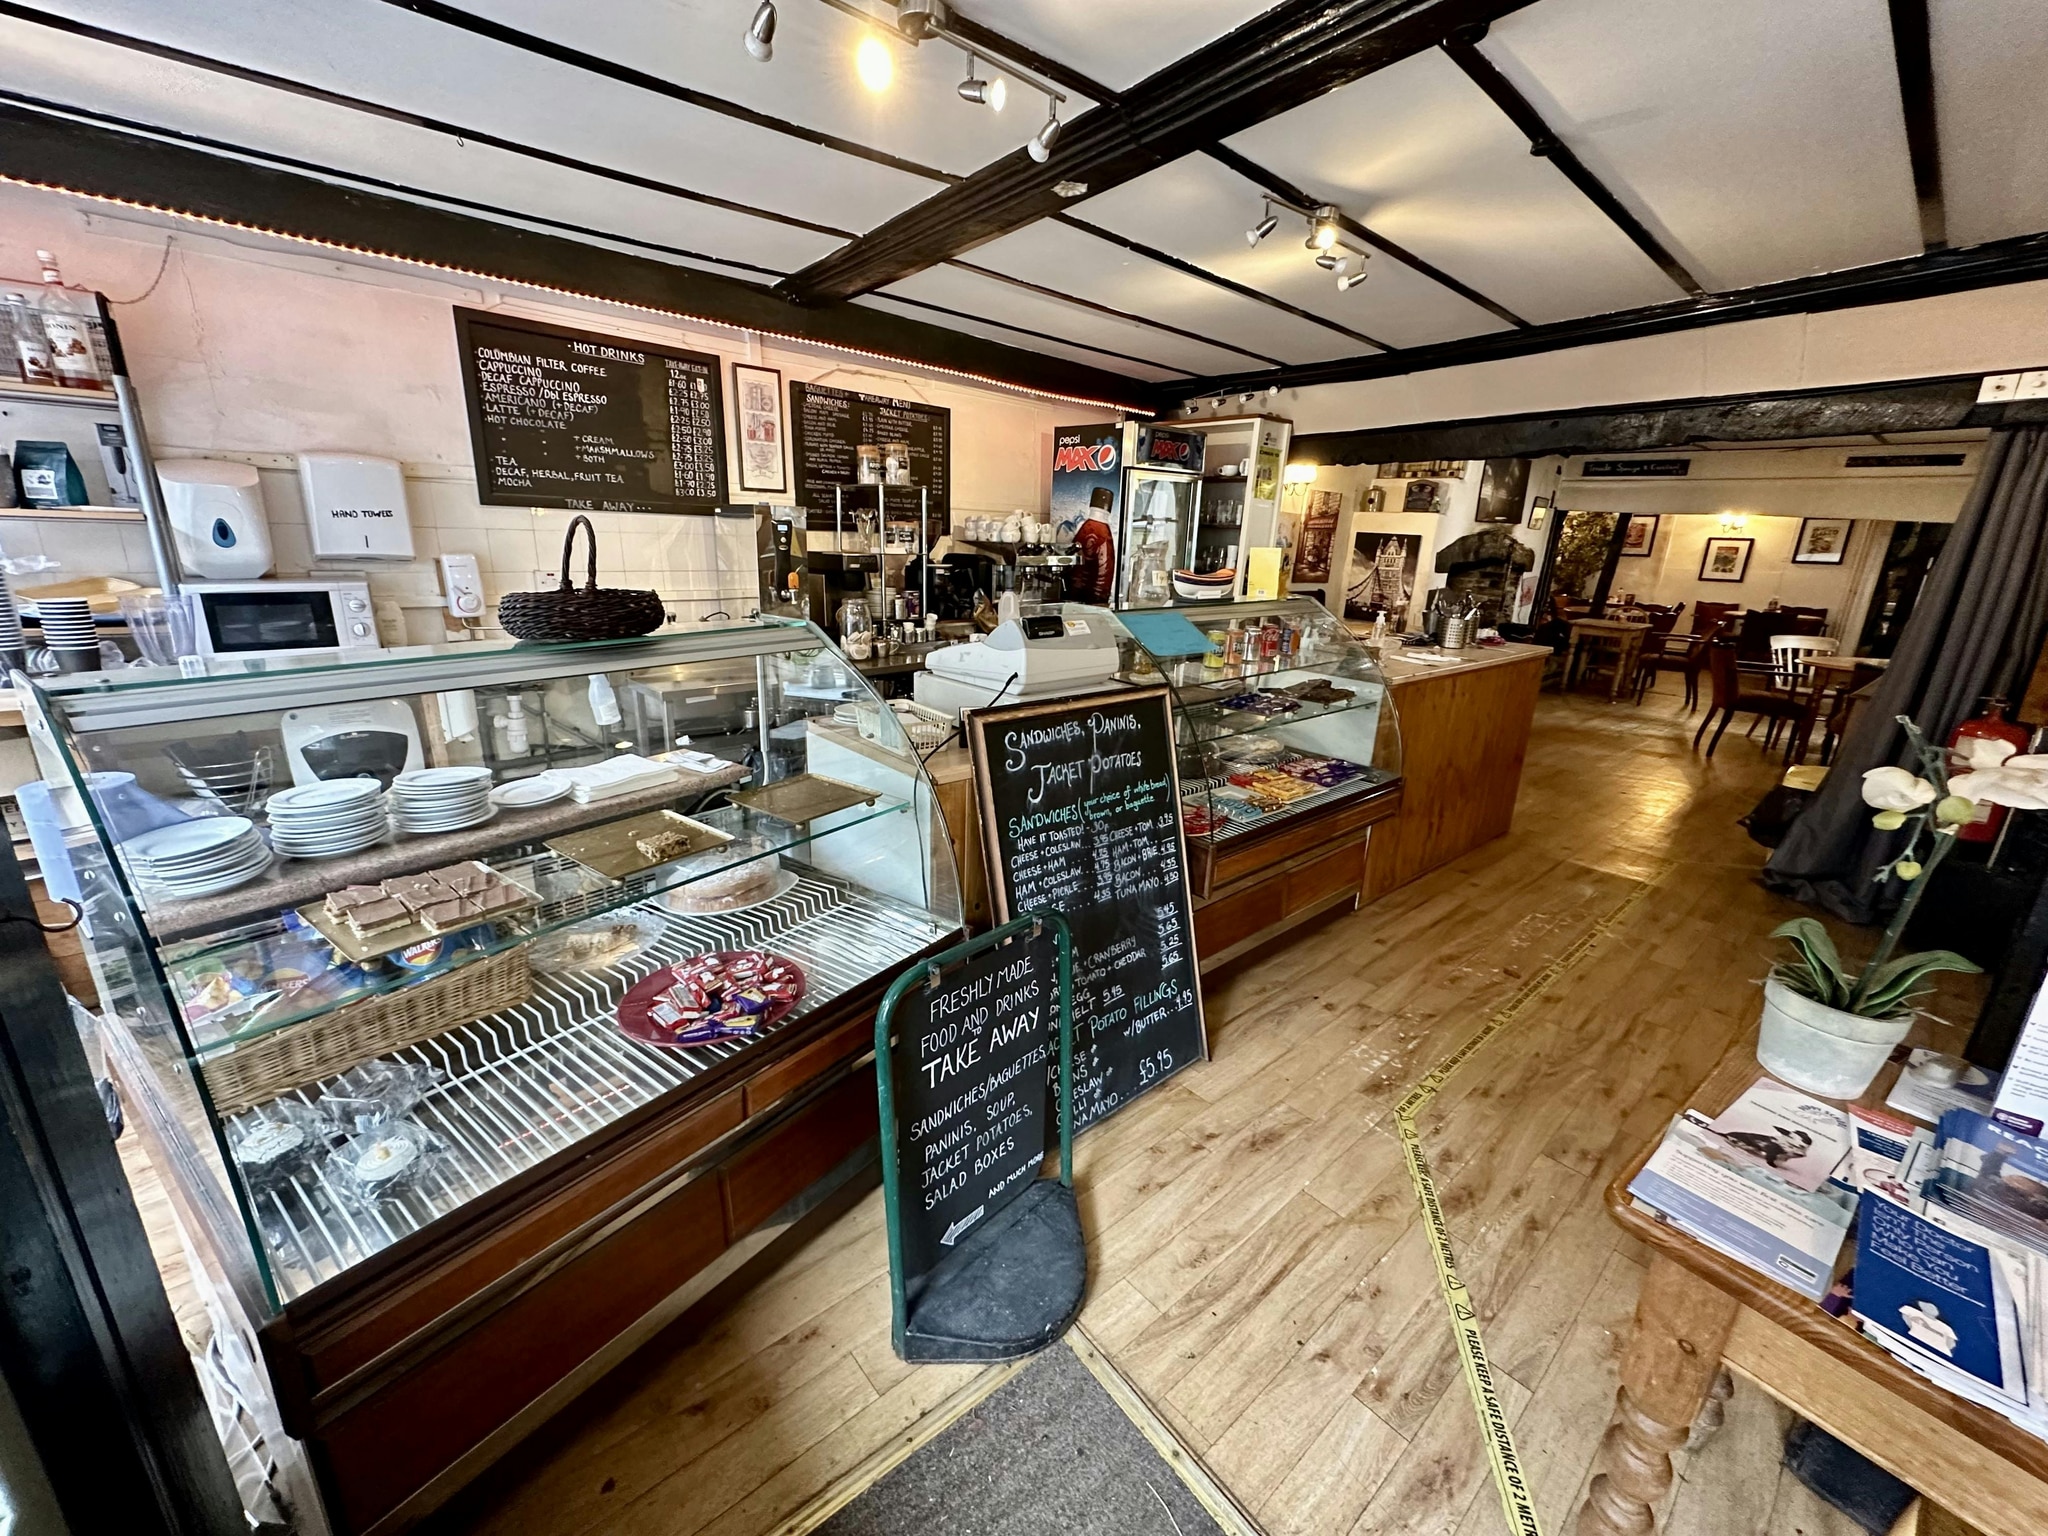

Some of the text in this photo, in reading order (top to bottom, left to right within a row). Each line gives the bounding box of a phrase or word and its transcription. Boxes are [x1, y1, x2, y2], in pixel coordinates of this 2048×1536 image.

[536, 356, 568, 371] FILTER
[571, 363, 607, 376] COFFEE
[573, 341, 645, 363] HOT DRINKS
[479, 359, 542, 377] CAPPUCCINO
[481, 371, 580, 392] DECAF CAPPUCCINO
[482, 381, 607, 405] ESPRESSO ESPRESSO
[485, 392, 546, 408] AMERICANO
[486, 403, 521, 415] LATTE
[487, 415, 567, 429] HOT CHOCOLATE
[582, 434, 614, 445] CREAM
[1059, 434, 1080, 446] pepsi
[1151, 439, 1181, 460] MAX
[495, 456, 517, 466] TEA
[582, 455, 605, 463] BOTH
[1054, 445, 1101, 473] MAX
[496, 466, 529, 478] DECAF,
[605, 473, 624, 483] TEA
[498, 477, 532, 487] MOCHA
[331, 509, 359, 518] HAND
[565, 499, 594, 510] TAKE
[1028, 751, 1141, 803] JACKET POTATOES
[1099, 791, 1121, 806] choice
[1123, 784, 1132, 800] of
[1133, 780, 1150, 794] white
[1115, 805, 1123, 813] or
[1125, 795, 1155, 812] baguette
[1010, 850, 1039, 868] CHEESE
[1109, 826, 1133, 841] CHEESE
[1137, 819, 1153, 832] TOM
[1017, 835, 1037, 852] HAVE
[1039, 832, 1049, 843] IT
[1049, 823, 1084, 842] TOASTED!
[1013, 836, 1149, 882] CHEESE HAM HAM TOM
[1015, 881, 1037, 900] HAM
[1113, 853, 1137, 872] BACON
[1017, 866, 1141, 912] CHEESE PICKLE BACON
[1115, 877, 1159, 900] TUNA MAYO
[1087, 936, 1136, 969] CRANBERRY
[930, 956, 1034, 1023] FRESHLY MADE
[1074, 967, 1107, 987] TOMATO
[921, 979, 1039, 1058] FOOD AND DRINKS
[971, 1026, 982, 1036] TO
[1087, 1008, 1127, 1039] POTATO
[921, 1006, 1039, 1089] TAKE AWAY
[1139, 1048, 1173, 1086] £5.95
[921, 1144, 970, 1188] JACKET
[1409, 1141, 1424, 1164] PLEASE
[925, 1136, 1015, 1210] SALAD BOXES
[988, 1181, 1005, 1199] AND
[1006, 1165, 1026, 1184] MUCH
[1421, 1181, 1434, 1198] SAFE
[1424, 1195, 1443, 1226] DISTANCE
[1873, 1199, 1975, 1253] Your Doctor
[1911, 1226, 1945, 1250] The
[1438, 1240, 1456, 1270] METRES
[1871, 1231, 1959, 1281] Make You
[1872, 1223, 1954, 1270] Who Can
[1873, 1216, 1979, 1273] Only Person
[1870, 1240, 1969, 1293] Feel Better
[1463, 1326, 1484, 1363] PLEASE
[1474, 1360, 1492, 1388] KEEP
[1483, 1392, 1503, 1423] SAFE
[1490, 1418, 1519, 1475] DISTANCE
[1507, 1473, 1523, 1493] OF
